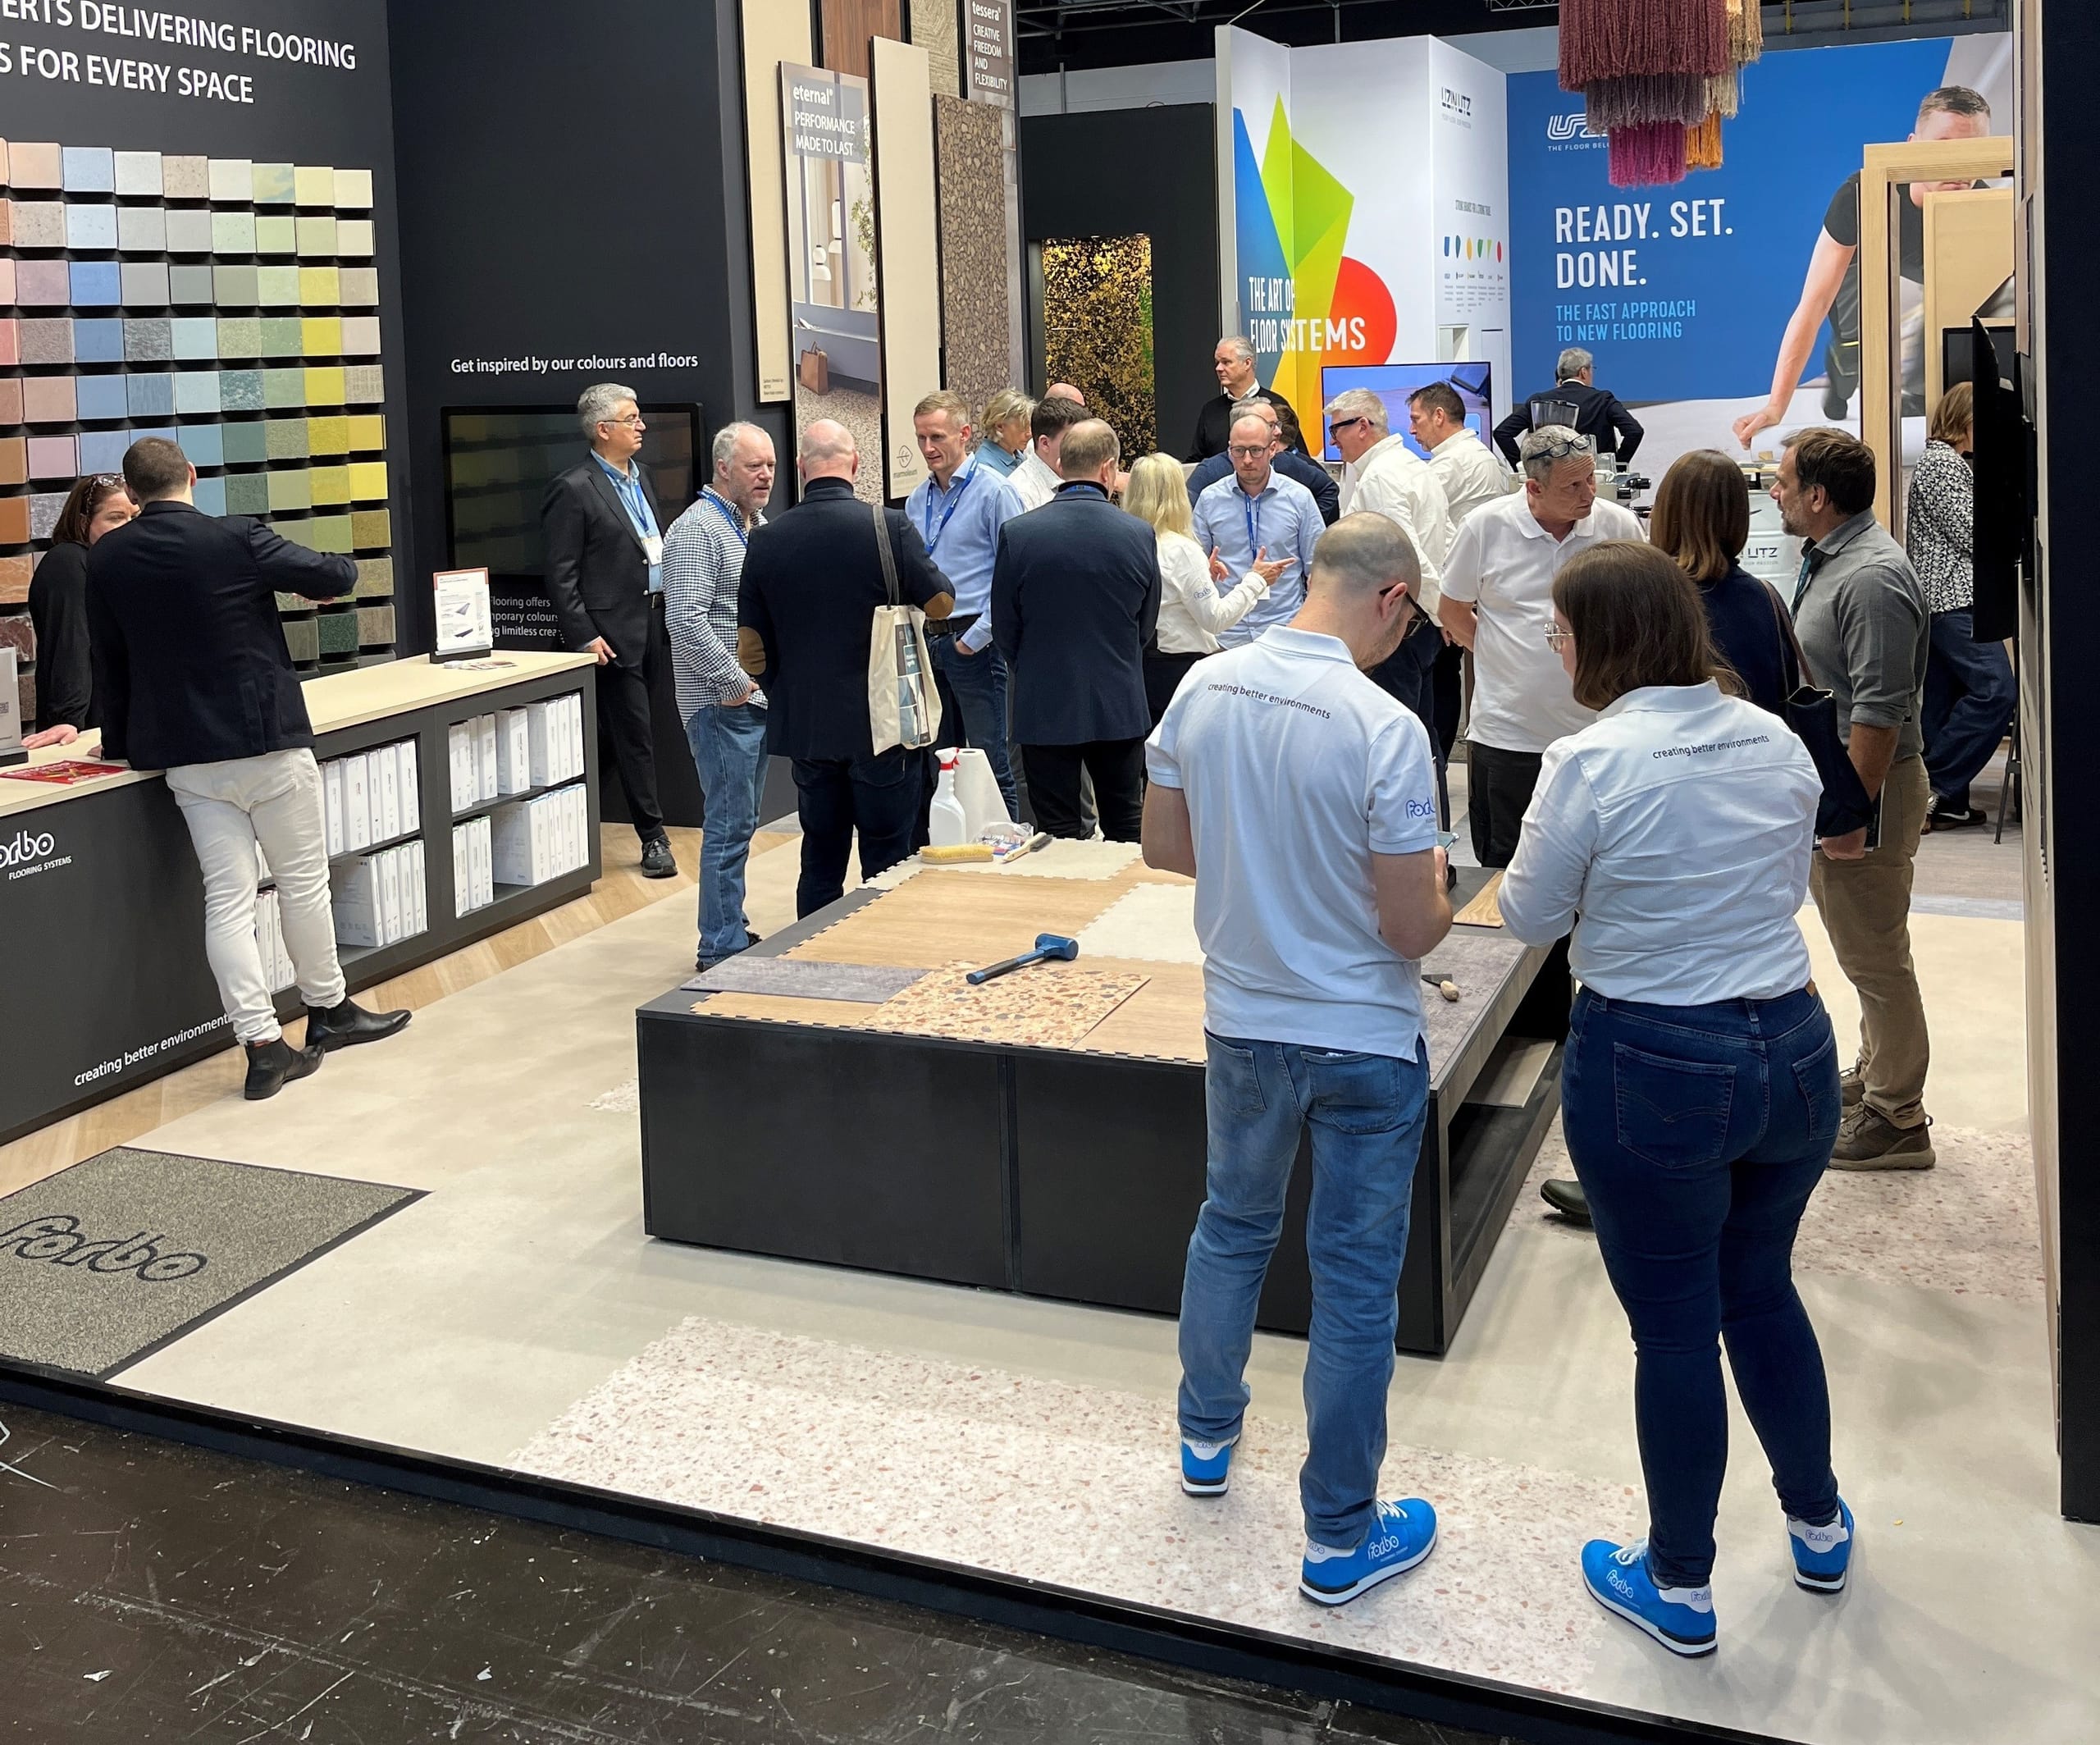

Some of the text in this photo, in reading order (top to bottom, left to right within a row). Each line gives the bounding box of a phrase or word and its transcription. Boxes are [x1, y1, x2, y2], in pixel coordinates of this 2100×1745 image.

[80, 1, 235, 53] DELIVERING
[241, 27, 356, 70] FLOORING
[973, 24, 1000, 42] CREATIVE
[974, 41, 1002, 58] FREEDOM
[21, 45, 80, 82] FOR
[86, 54, 171, 93] EVERY
[177, 67, 254, 103] SPACE
[975, 57, 988, 70] AND
[975, 75, 1007, 90] FLEXIBILITY
[795, 111, 856, 135] PERFORMANCE
[796, 135, 854, 157] MADE TO LAST
[1565, 143, 1590, 151] FLOOR
[1555, 199, 1733, 244] READY. SET.
[1556, 249, 1647, 289] DONE.
[1249, 276, 1266, 312] THE
[1268, 278, 1283, 312] ART
[1556, 300, 1696, 322] THE FAST APPROACH
[1250, 317, 1366, 354] FLOOR SYSTEMS
[1556, 322, 1682, 342] TO NEW FLOORING
[451, 353, 698, 375] Get inspired by our colours and floors
[526, 596, 550, 607] offers
[502, 625, 537, 636] limitless
[1208, 683, 1331, 719] creating better environments
[1653, 734, 1769, 759] creating better environments
[8, 855, 72, 880] FLOORING SYSTEMS
[74, 1055, 122, 1087] creating
[125, 1041, 158, 1066] better
